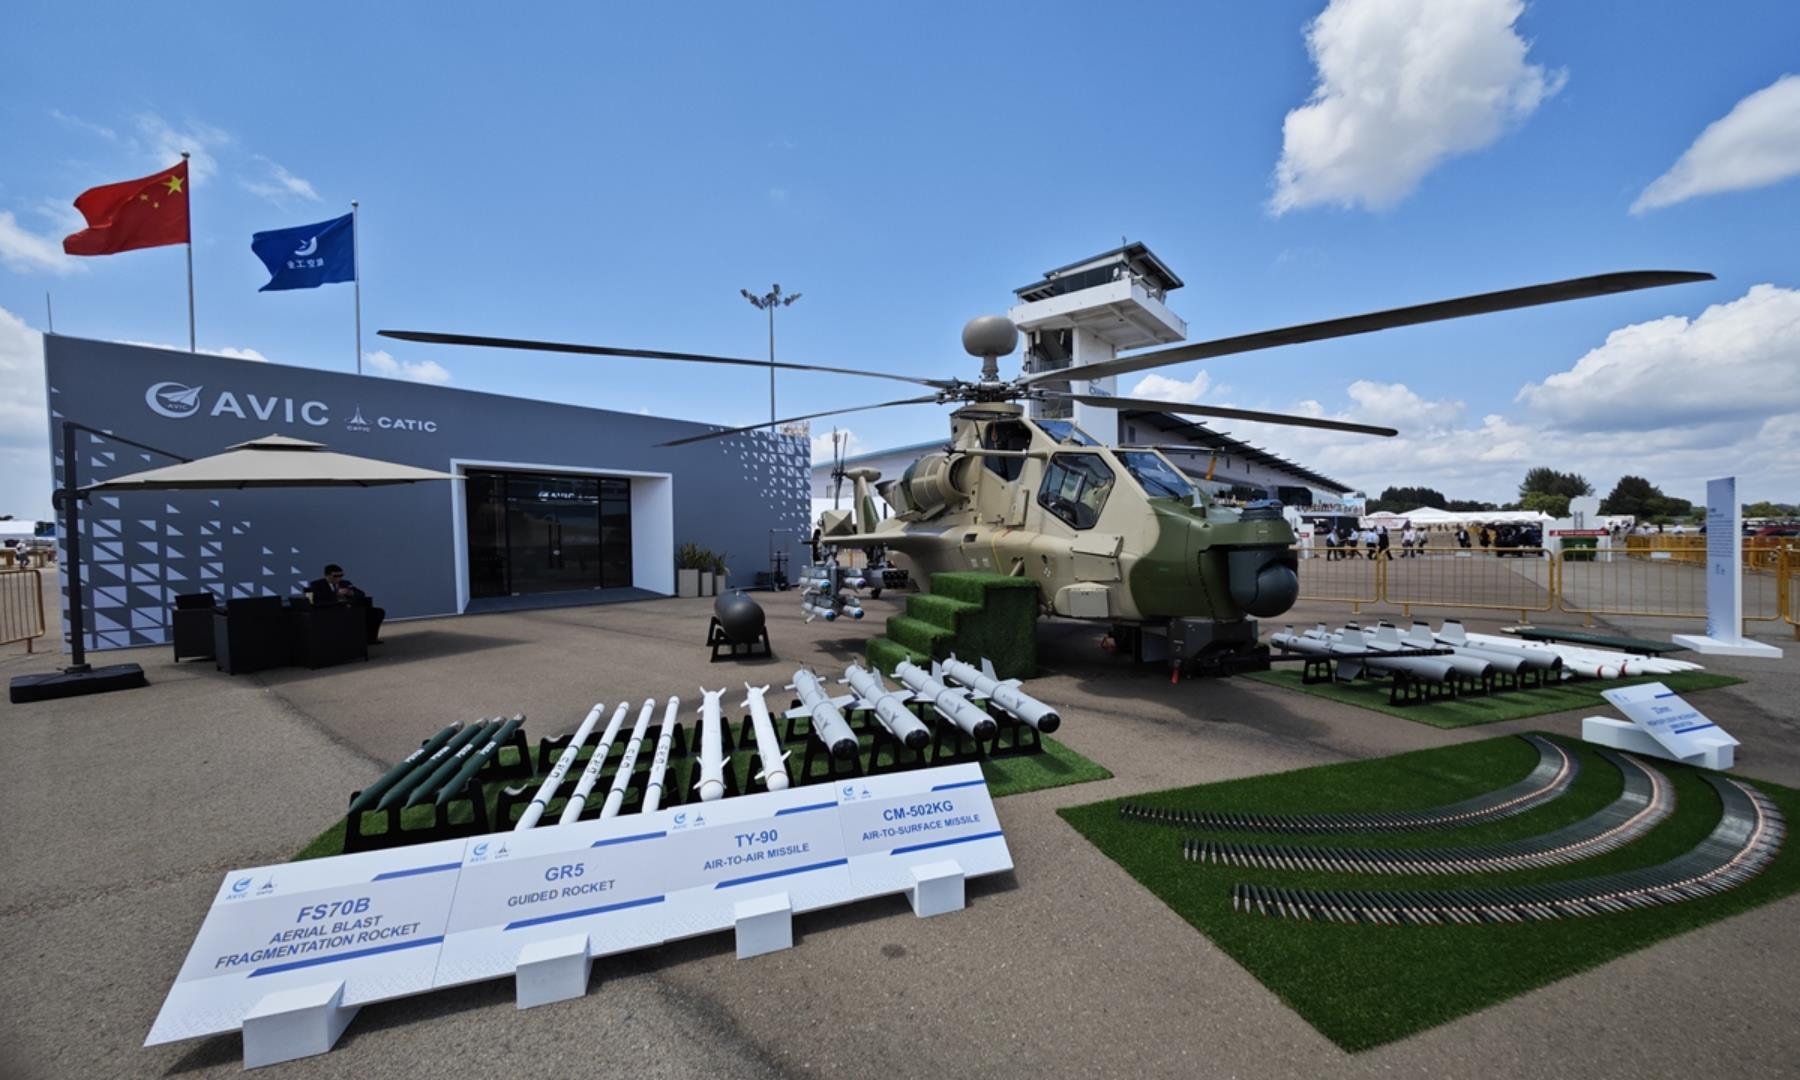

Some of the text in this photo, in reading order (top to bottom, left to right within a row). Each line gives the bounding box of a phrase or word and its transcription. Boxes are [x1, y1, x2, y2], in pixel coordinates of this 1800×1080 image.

[209, 391, 329, 426] AVIC
[377, 416, 438, 433] CATIC
[883, 800, 954, 821] CM-502KG
[735, 829, 778, 848] TY-90
[862, 814, 980, 841] AIR-TO-SURFACE MISSILE
[703, 843, 809, 871] AIR-TO-AIR MISSILE
[544, 862, 585, 882] GR5
[507, 879, 616, 908] GUIDED ROCKET
[296, 897, 371, 923] FS70B
[269, 915, 384, 945] AERIAL BLAST
[214, 922, 420, 969] FRAGMENTATION ROCKET
